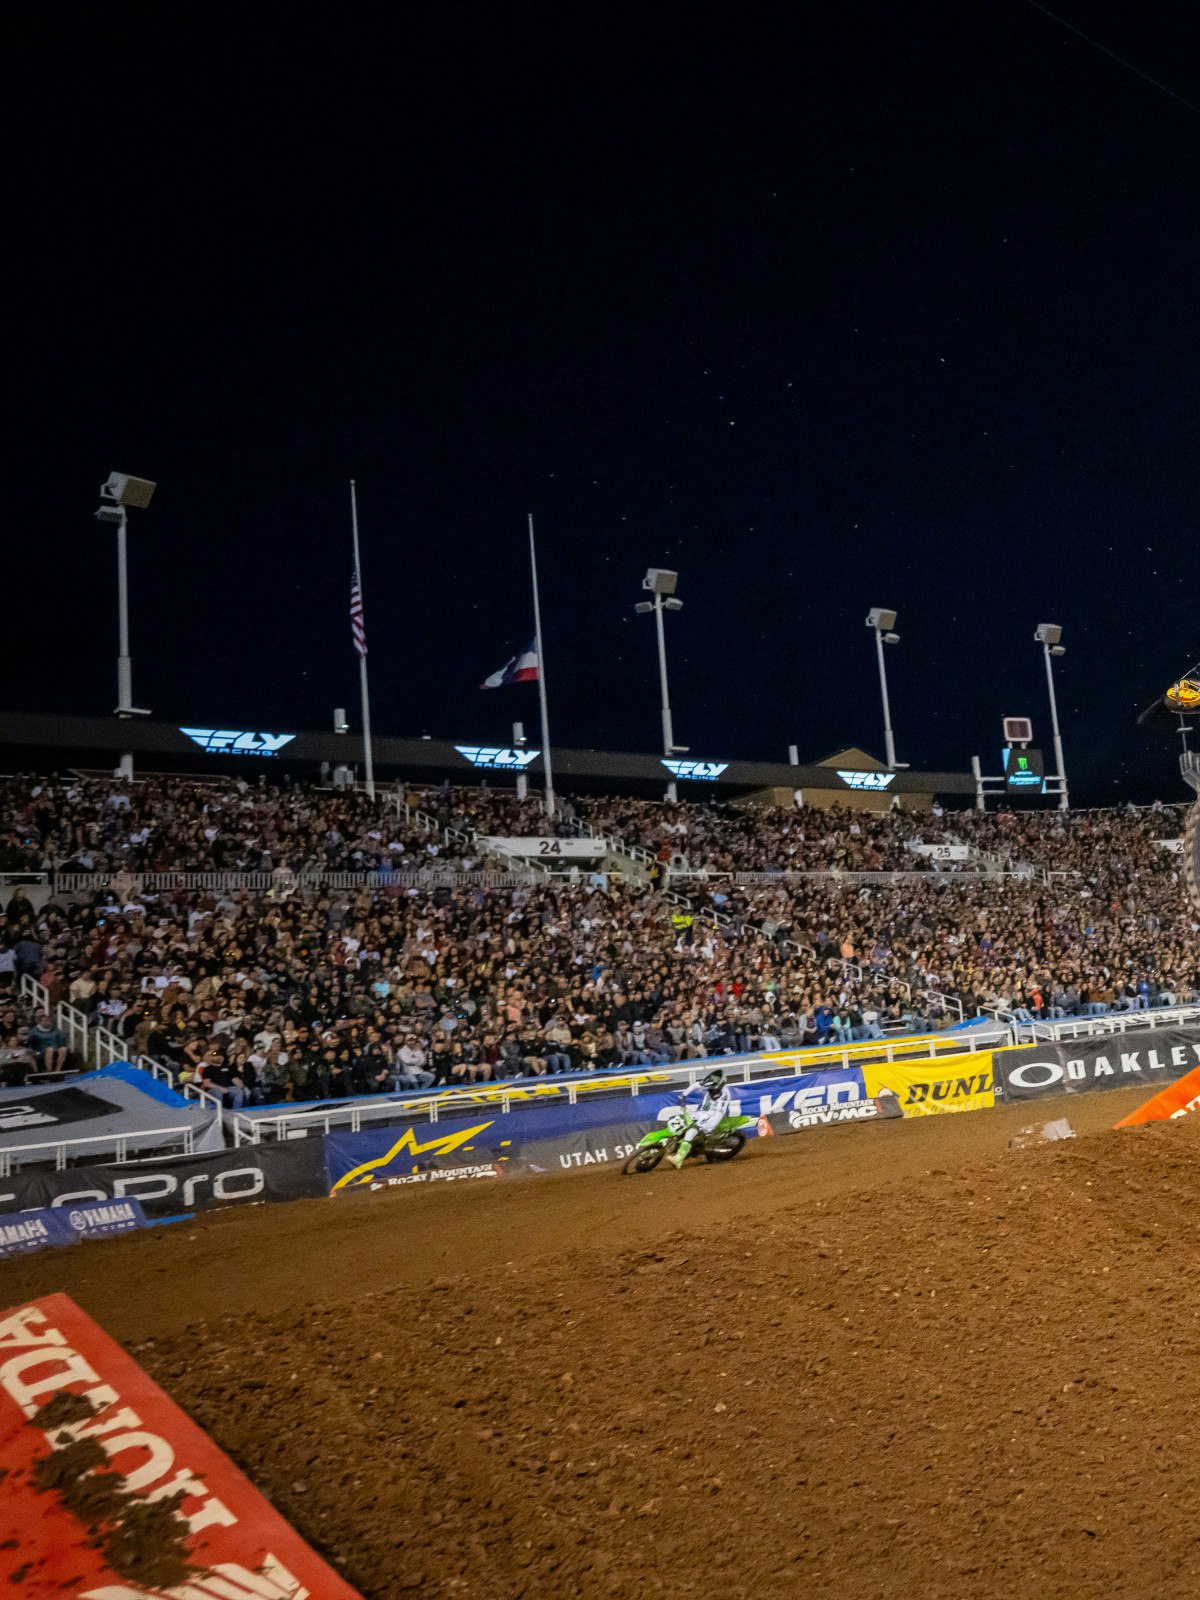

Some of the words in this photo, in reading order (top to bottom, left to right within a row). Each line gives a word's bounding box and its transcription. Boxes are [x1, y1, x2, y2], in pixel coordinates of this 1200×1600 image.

[195, 728, 297, 751] FLY
[205, 747, 278, 757] RACING
[465, 746, 541, 765] FLY
[667, 760, 729, 776] FLY
[842, 771, 896, 786] FLY
[539, 841, 562, 856] 24
[937, 847, 951, 858] 25
[904, 1072, 993, 1105] DUNL
[801, 1104, 828, 1115] ROCKY
[830, 1098, 875, 1110] MOUNTAIN
[559, 1148, 609, 1169] UTAH
[388, 1173, 428, 1186] ROCKY
[430, 1163, 493, 1180] MOUNTAIN
[83, 1203, 136, 1228] YAMAHA
